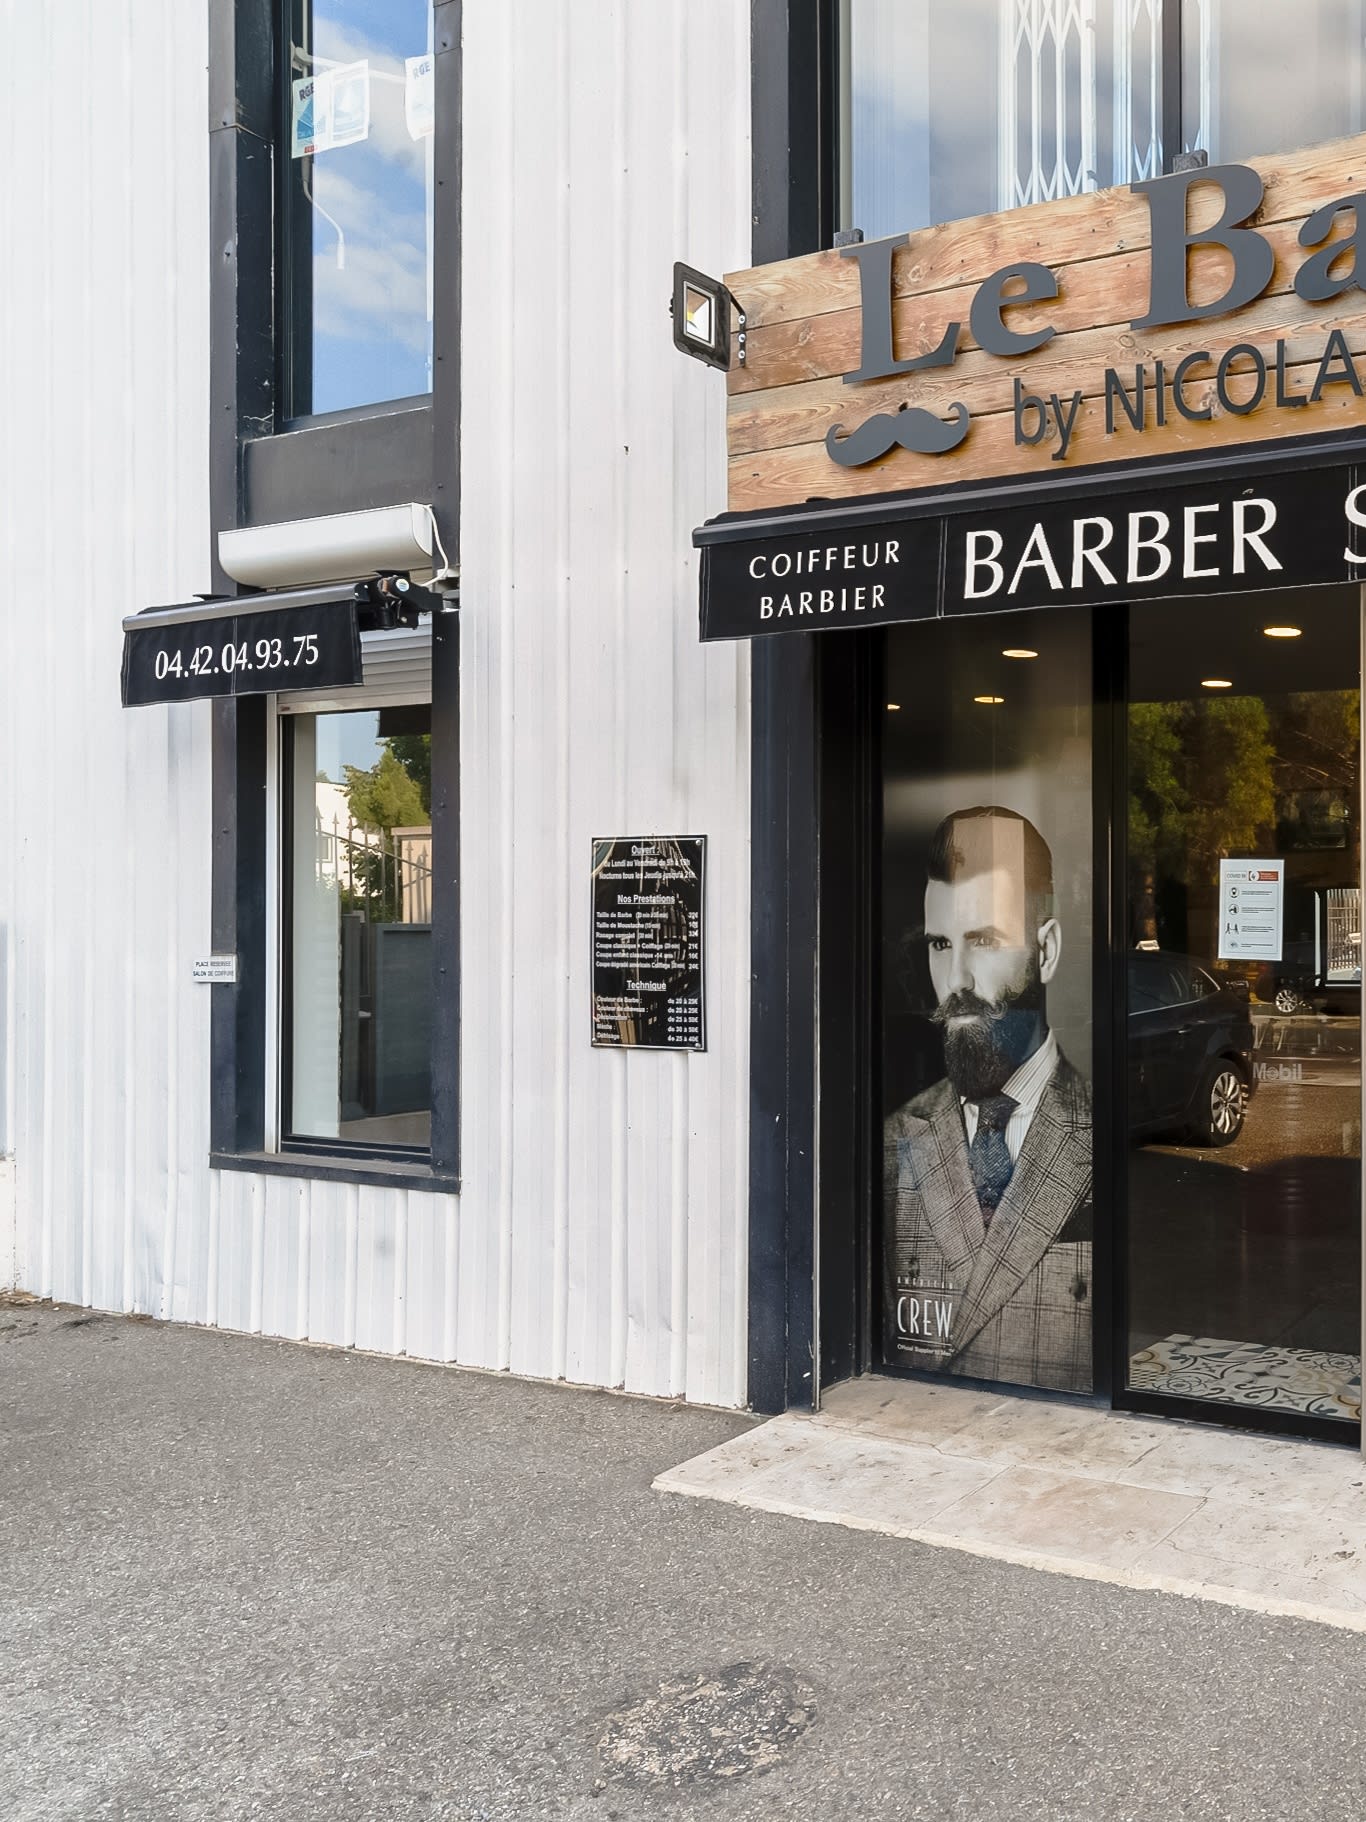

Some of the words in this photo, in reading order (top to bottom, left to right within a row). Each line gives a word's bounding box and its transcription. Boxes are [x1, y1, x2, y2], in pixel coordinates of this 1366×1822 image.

[839, 232, 1059, 385] Le
[1014, 378, 1082, 460] by
[749, 540, 900, 579] COIFFEUR
[963, 497, 1283, 600] BARBER
[760, 584, 885, 620] BARBIER
[155, 634, 319, 680] 04.42.04.93.75
[617, 894, 632, 903] Nos
[634, 894, 675, 904] Prestations
[626, 980, 667, 991] Technique
[1253, 1063, 1302, 1080] Mobil
[897, 1296, 953, 1338] CREW
